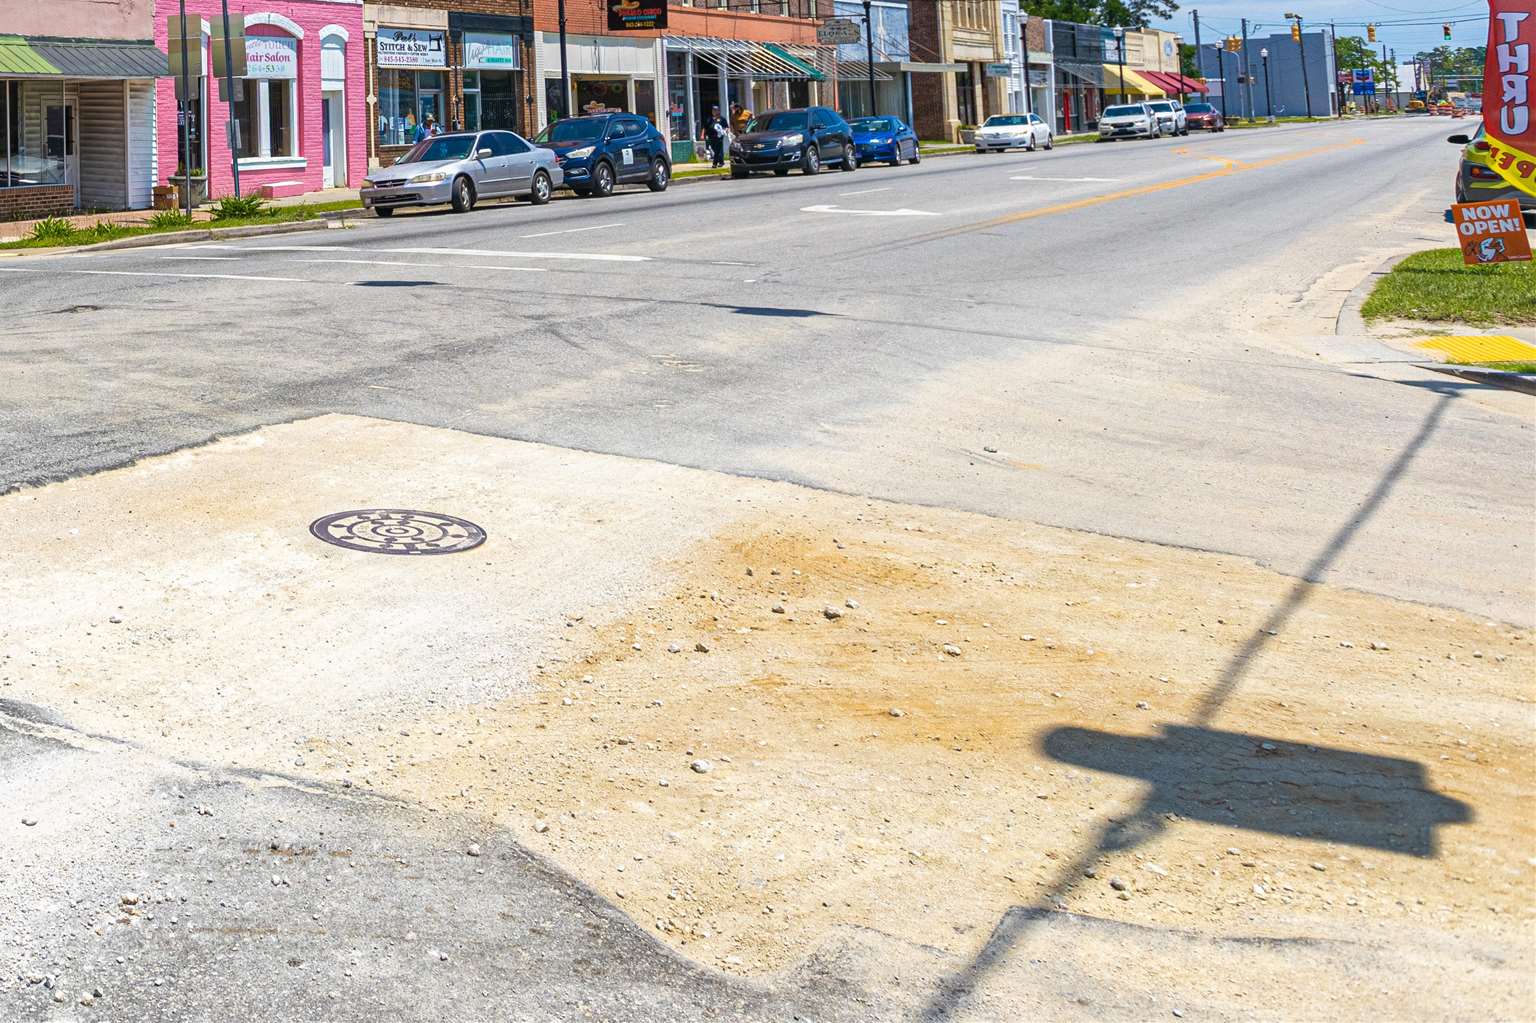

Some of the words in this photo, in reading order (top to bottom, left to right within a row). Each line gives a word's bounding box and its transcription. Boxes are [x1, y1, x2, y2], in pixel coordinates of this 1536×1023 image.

[379, 42, 406, 51] STITCH
[413, 42, 428, 52] SEW
[246, 52, 264, 62] air
[264, 51, 290, 63] Salon
[1462, 204, 1510, 220] NOW
[1459, 217, 1521, 236] OPEN!
